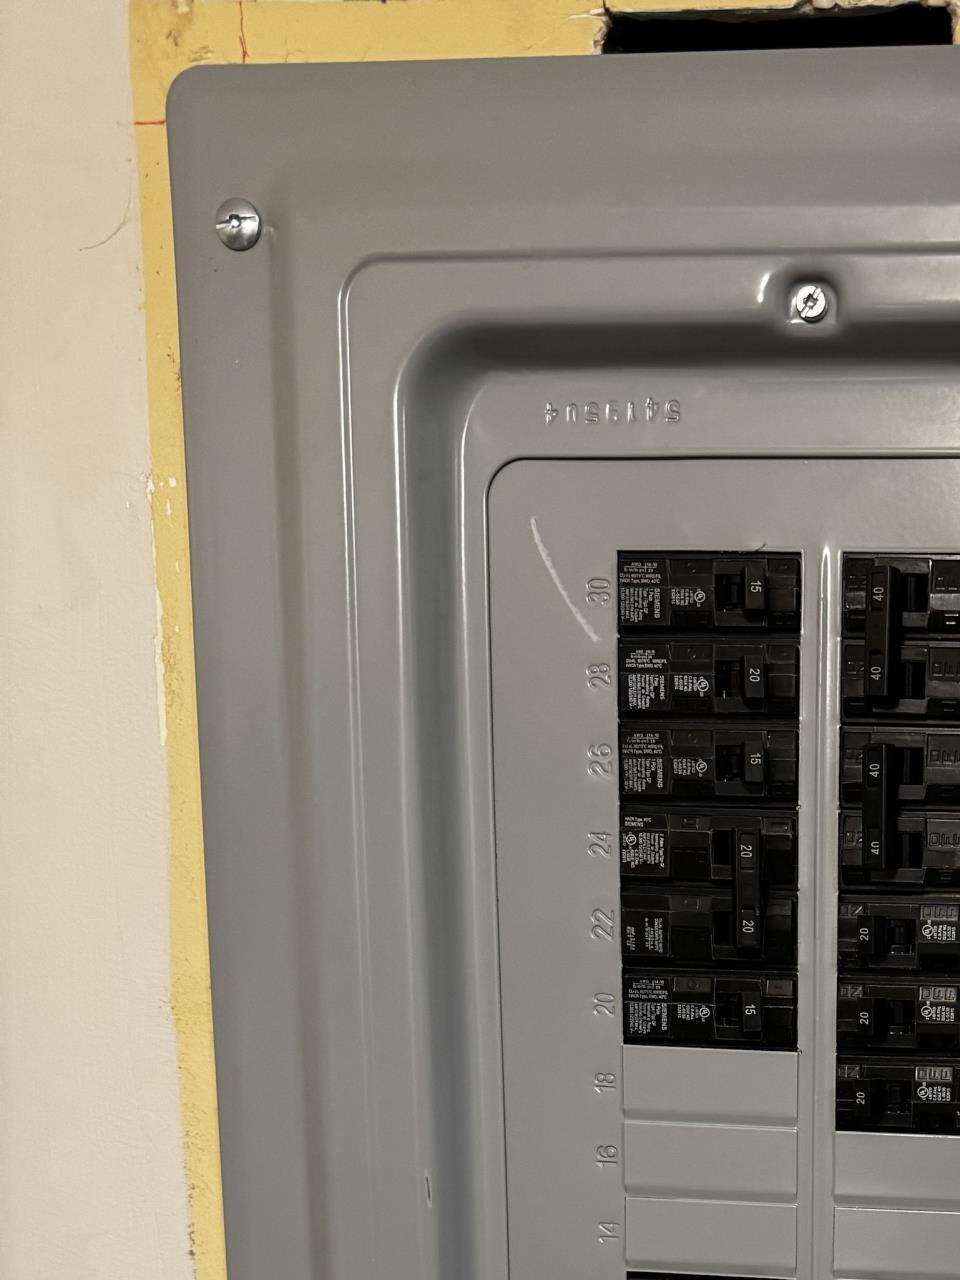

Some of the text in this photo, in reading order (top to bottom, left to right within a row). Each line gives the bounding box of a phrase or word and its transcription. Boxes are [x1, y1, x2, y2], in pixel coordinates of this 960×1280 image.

[586, 578, 611, 607] 30
[750, 580, 762, 593] 15
[872, 586, 885, 602] 40
[586, 663, 611, 689] 28
[749, 668, 761, 682] 20
[869, 665, 882, 681] 40
[587, 743, 612, 777] 26
[750, 752, 762, 765] 15
[869, 763, 880, 778] 40
[587, 831, 612, 858] 24
[740, 844, 753, 858] 20
[870, 841, 880, 856] 40
[590, 908, 615, 941] 22
[742, 919, 754, 934] 20
[859, 927, 869, 942] 20
[593, 992, 616, 1019] 20
[745, 1004, 756, 1016] 15
[859, 1011, 869, 1025] 20
[593, 1072, 616, 1094] 18
[856, 1091, 866, 1105] 20
[595, 1145, 618, 1169] 16
[598, 1221, 619, 1244] 14
